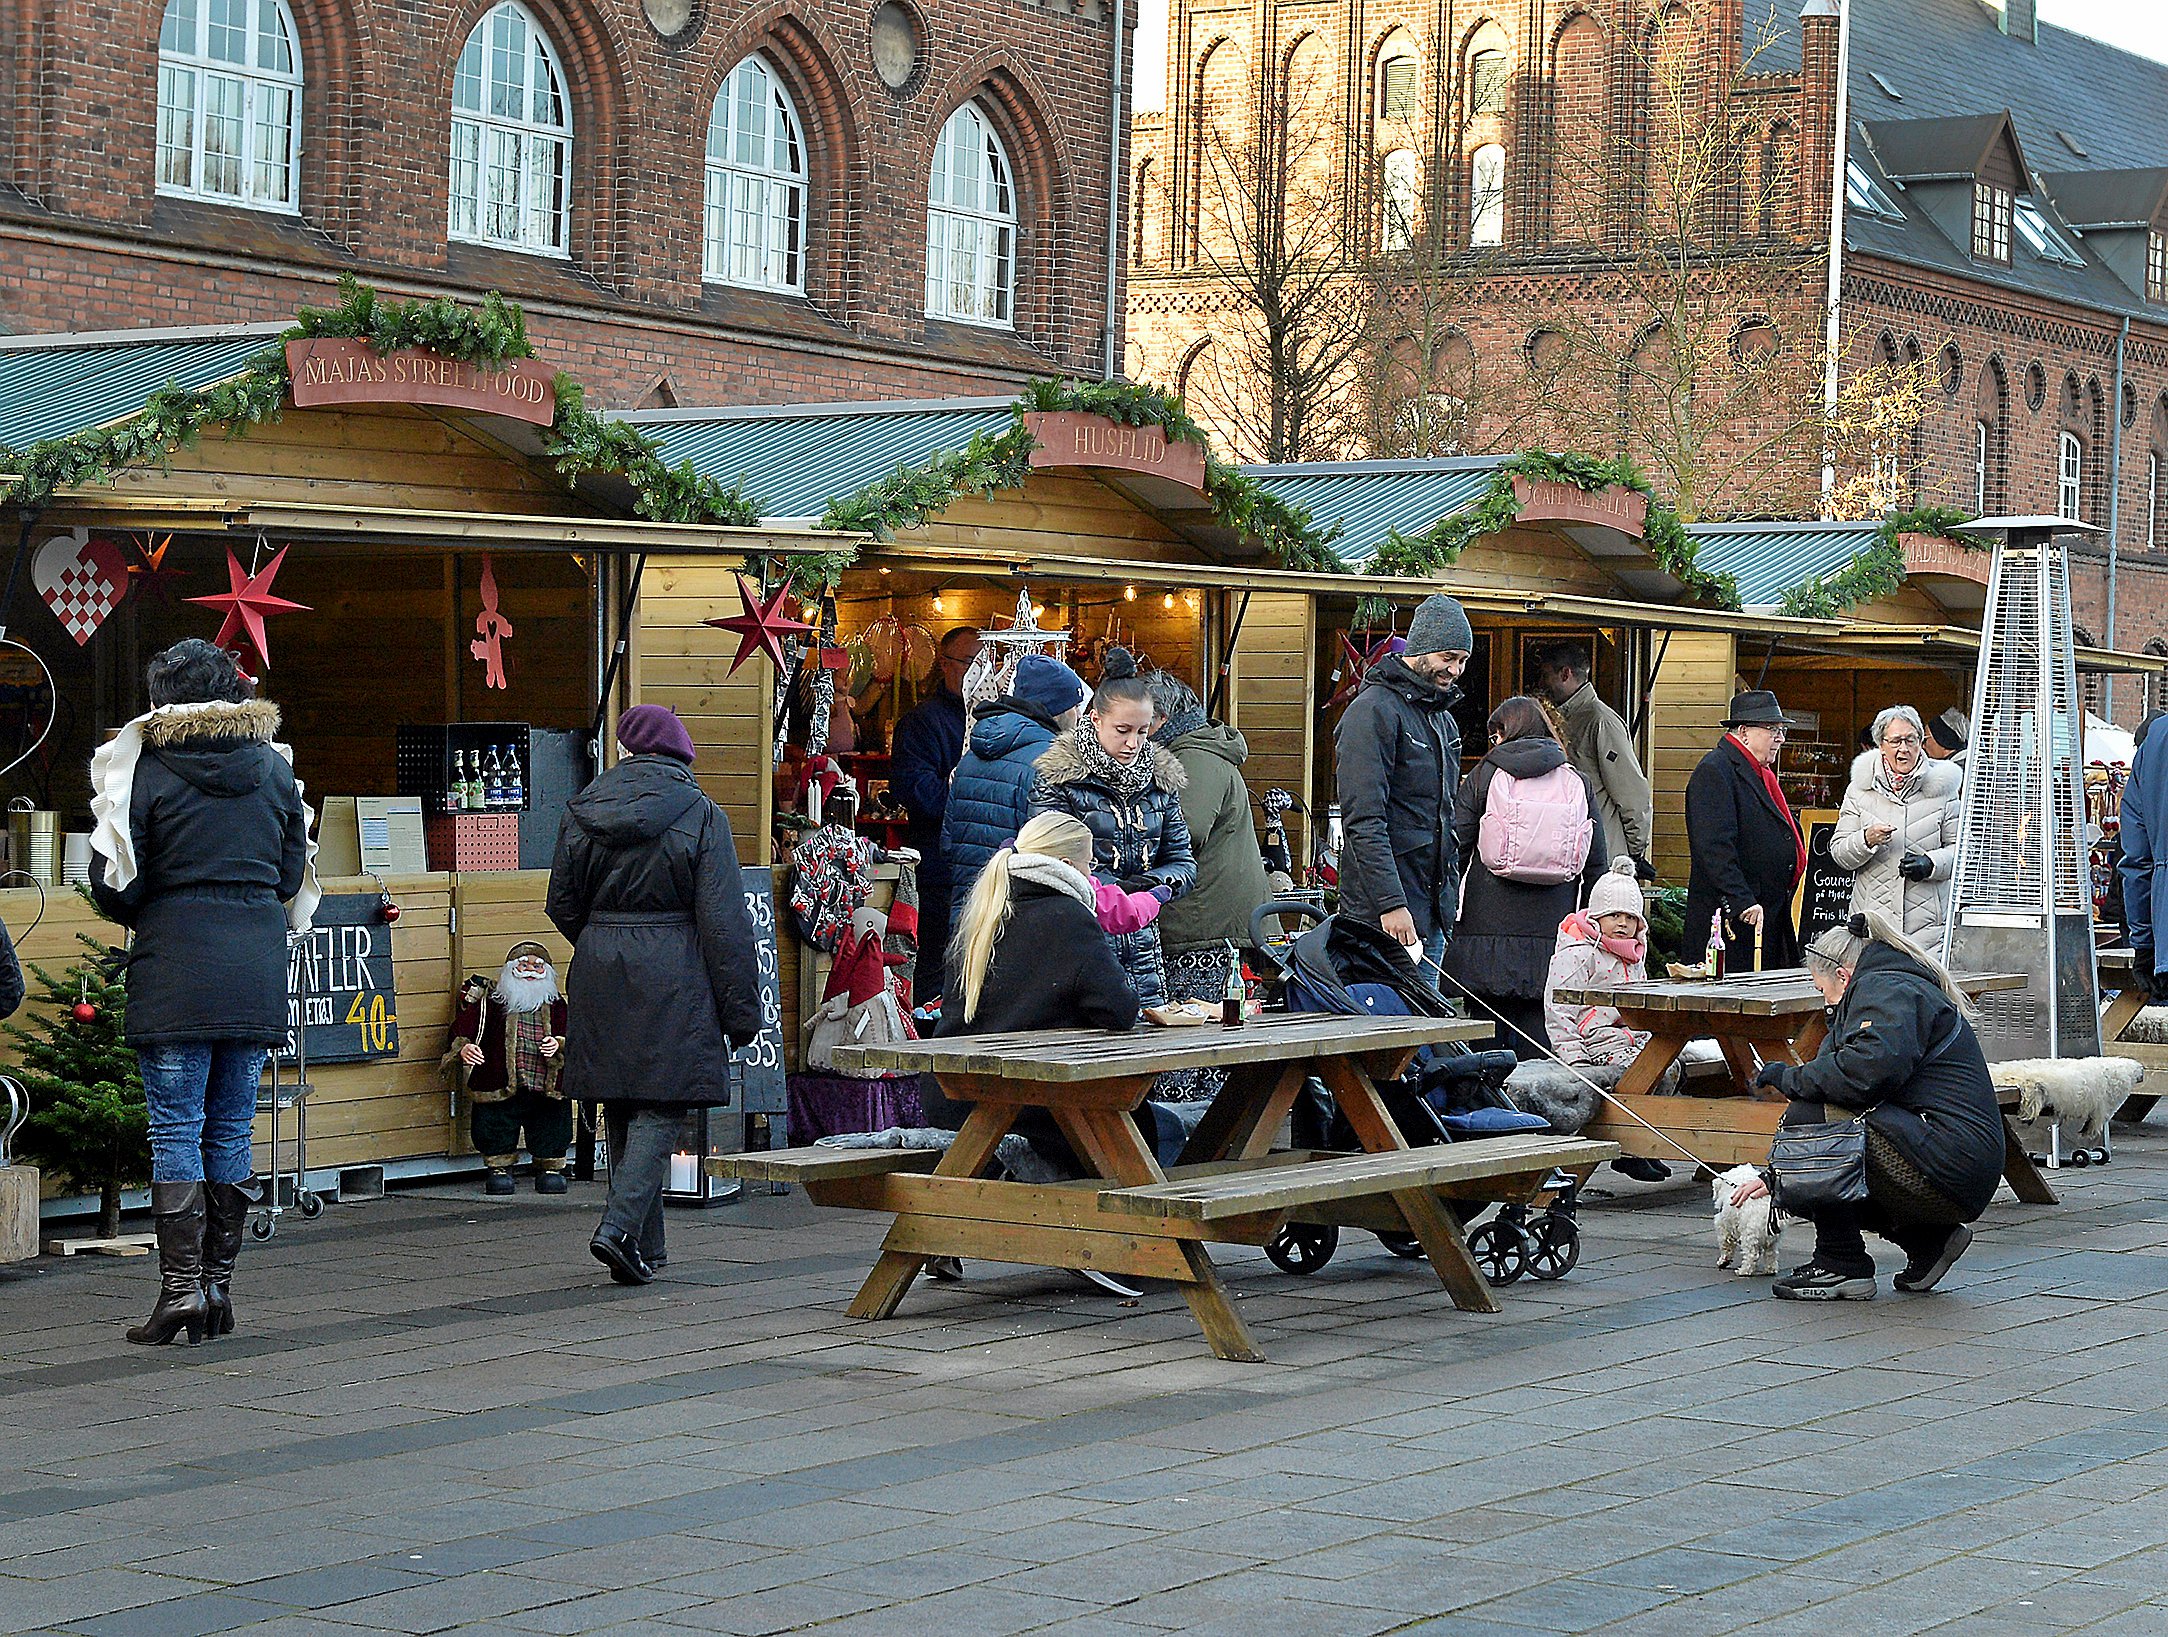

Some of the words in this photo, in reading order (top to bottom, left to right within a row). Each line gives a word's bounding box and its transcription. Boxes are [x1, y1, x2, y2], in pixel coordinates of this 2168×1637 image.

[305, 355, 387, 386] MAJAS
[1073, 426, 1167, 465] HUSFLID
[1813, 906, 1836, 920] Friis
